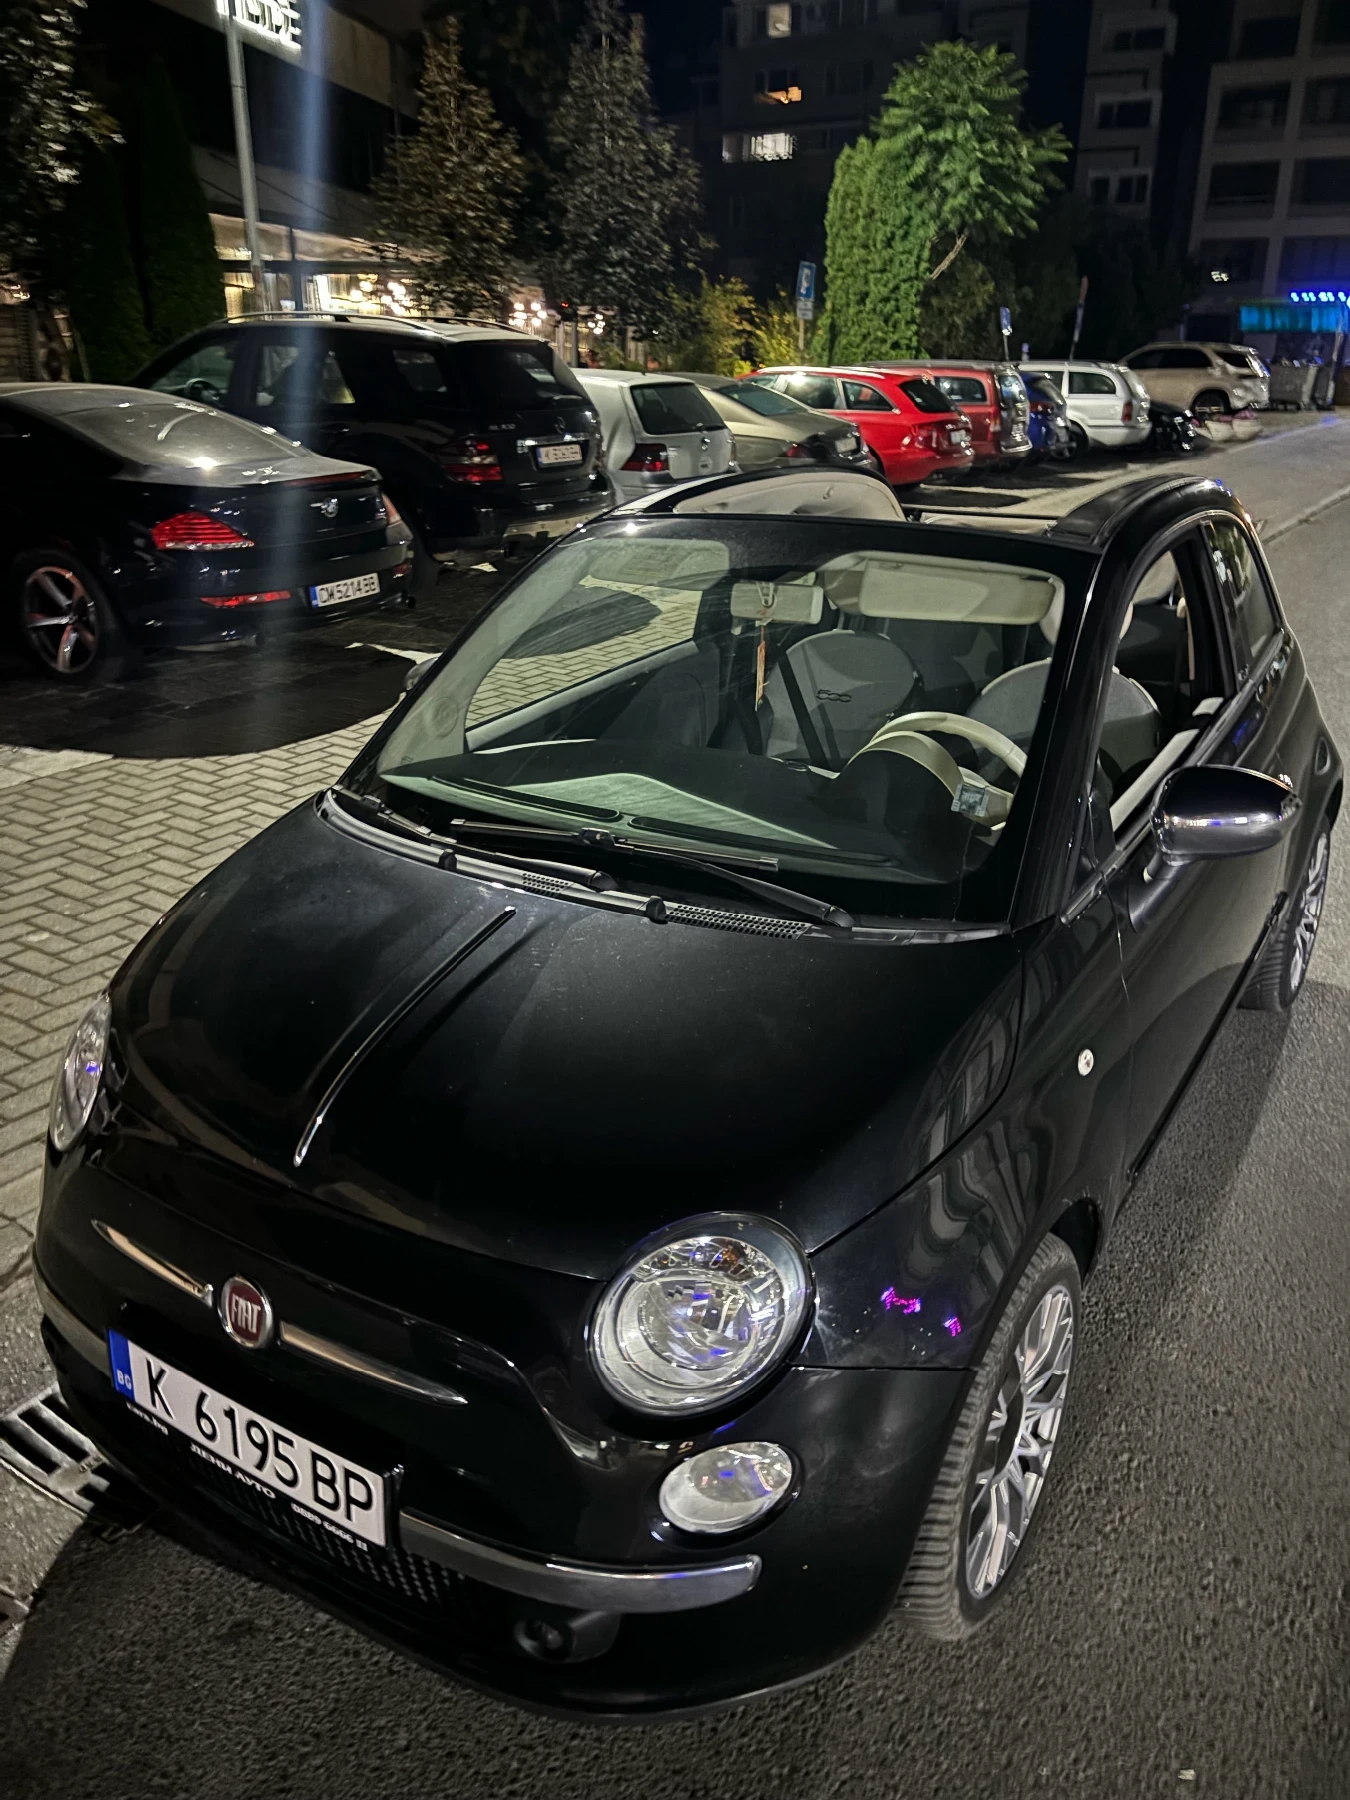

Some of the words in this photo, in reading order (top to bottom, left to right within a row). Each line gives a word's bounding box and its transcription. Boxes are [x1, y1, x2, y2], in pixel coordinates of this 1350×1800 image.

[816, 689, 853, 703] 500
[231, 1293, 261, 1334] FIAT
[116, 1369, 132, 1390] BG
[145, 1357, 174, 1419] K
[195, 1390, 300, 1489] 6195
[310, 1448, 373, 1523] BP
